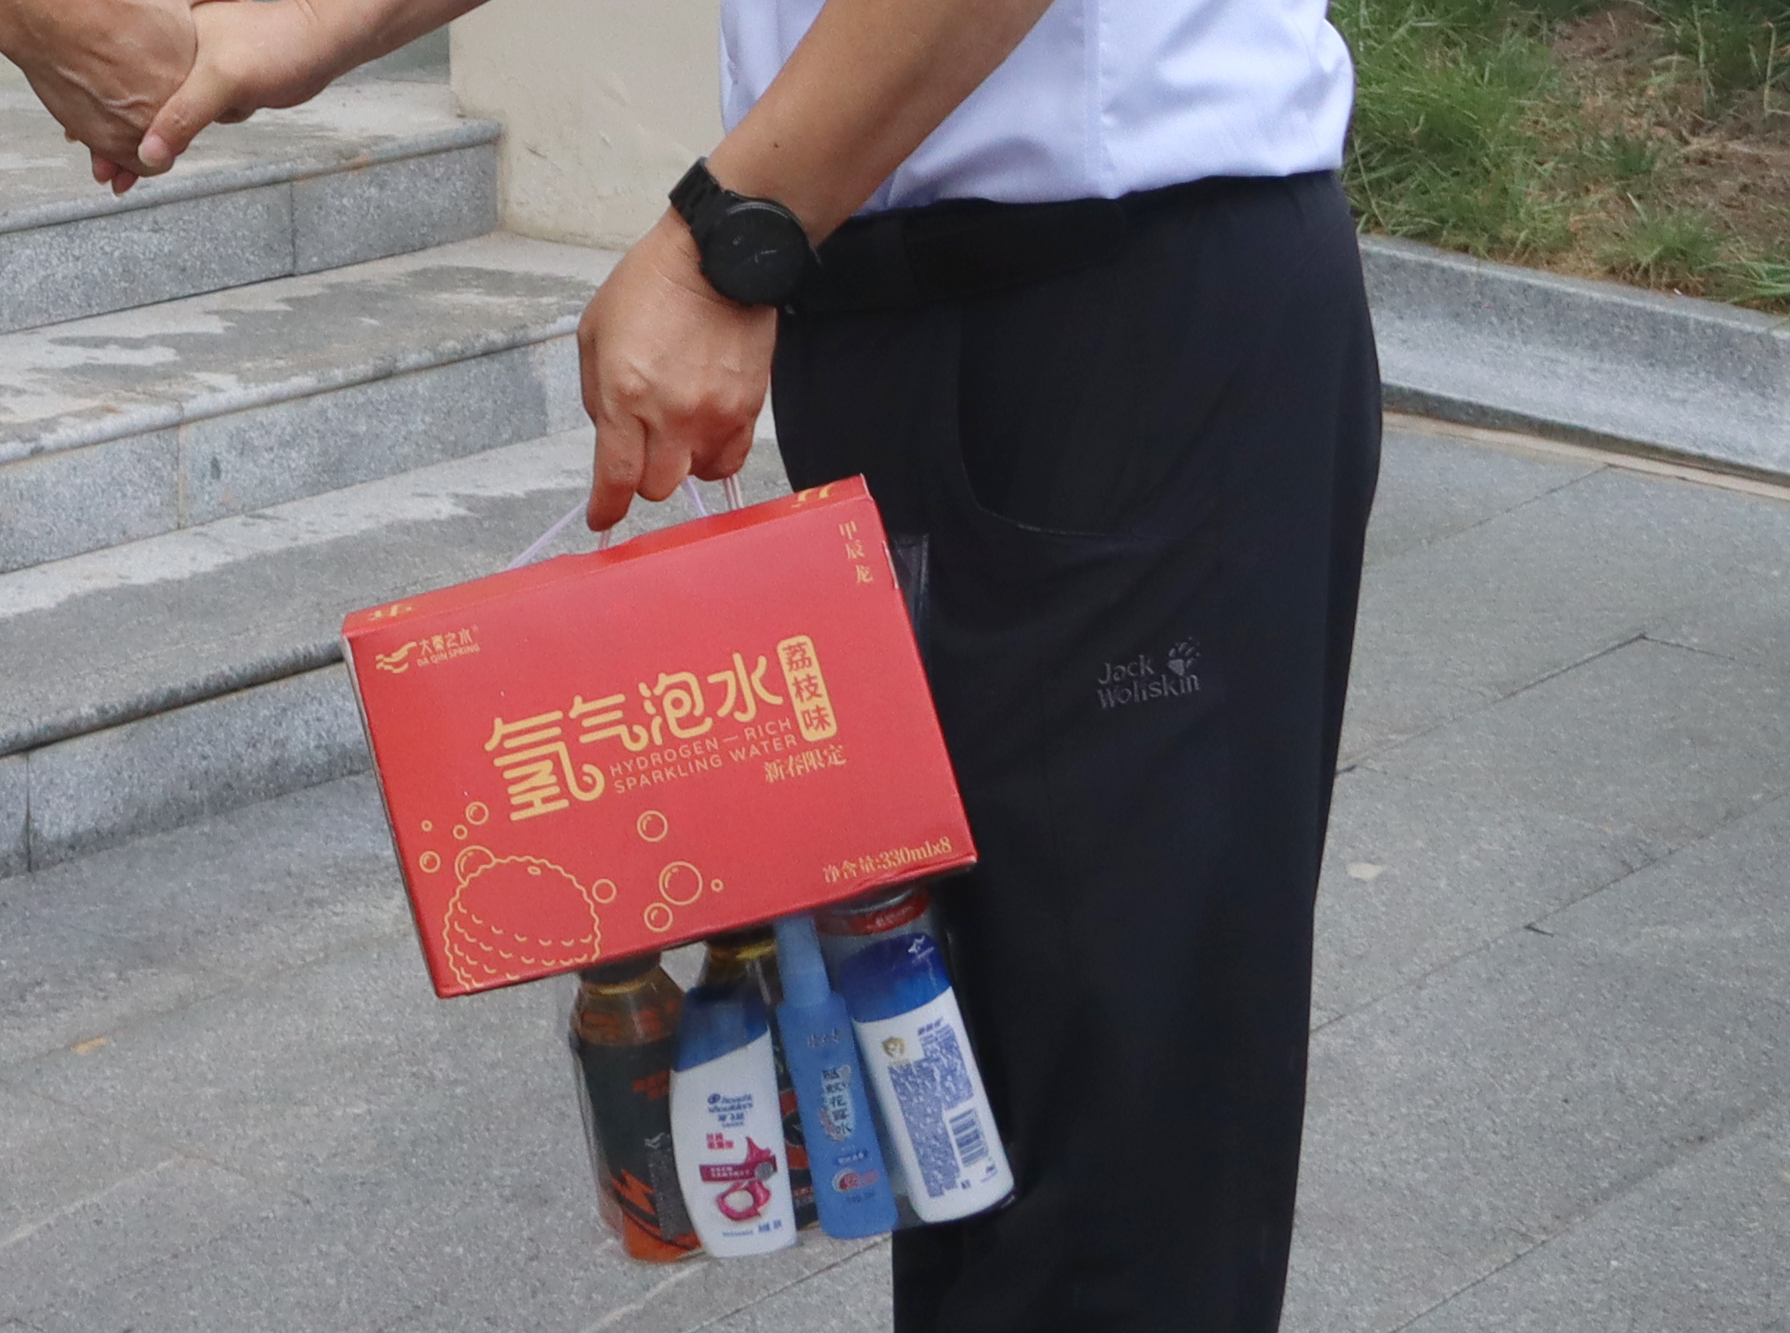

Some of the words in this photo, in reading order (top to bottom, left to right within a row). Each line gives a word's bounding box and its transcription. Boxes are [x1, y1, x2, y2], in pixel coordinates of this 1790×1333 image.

[784, 640, 833, 732] 荔枝味
[1096, 674, 1201, 709] Wolfskin
[1097, 654, 1156, 684] Jack
[485, 652, 784, 821] 氢气泡水
[609, 735, 719, 778] HYDROGEN
[744, 717, 792, 742] RICH
[614, 754, 723, 795] SPARKLING
[730, 734, 798, 763] WATER
